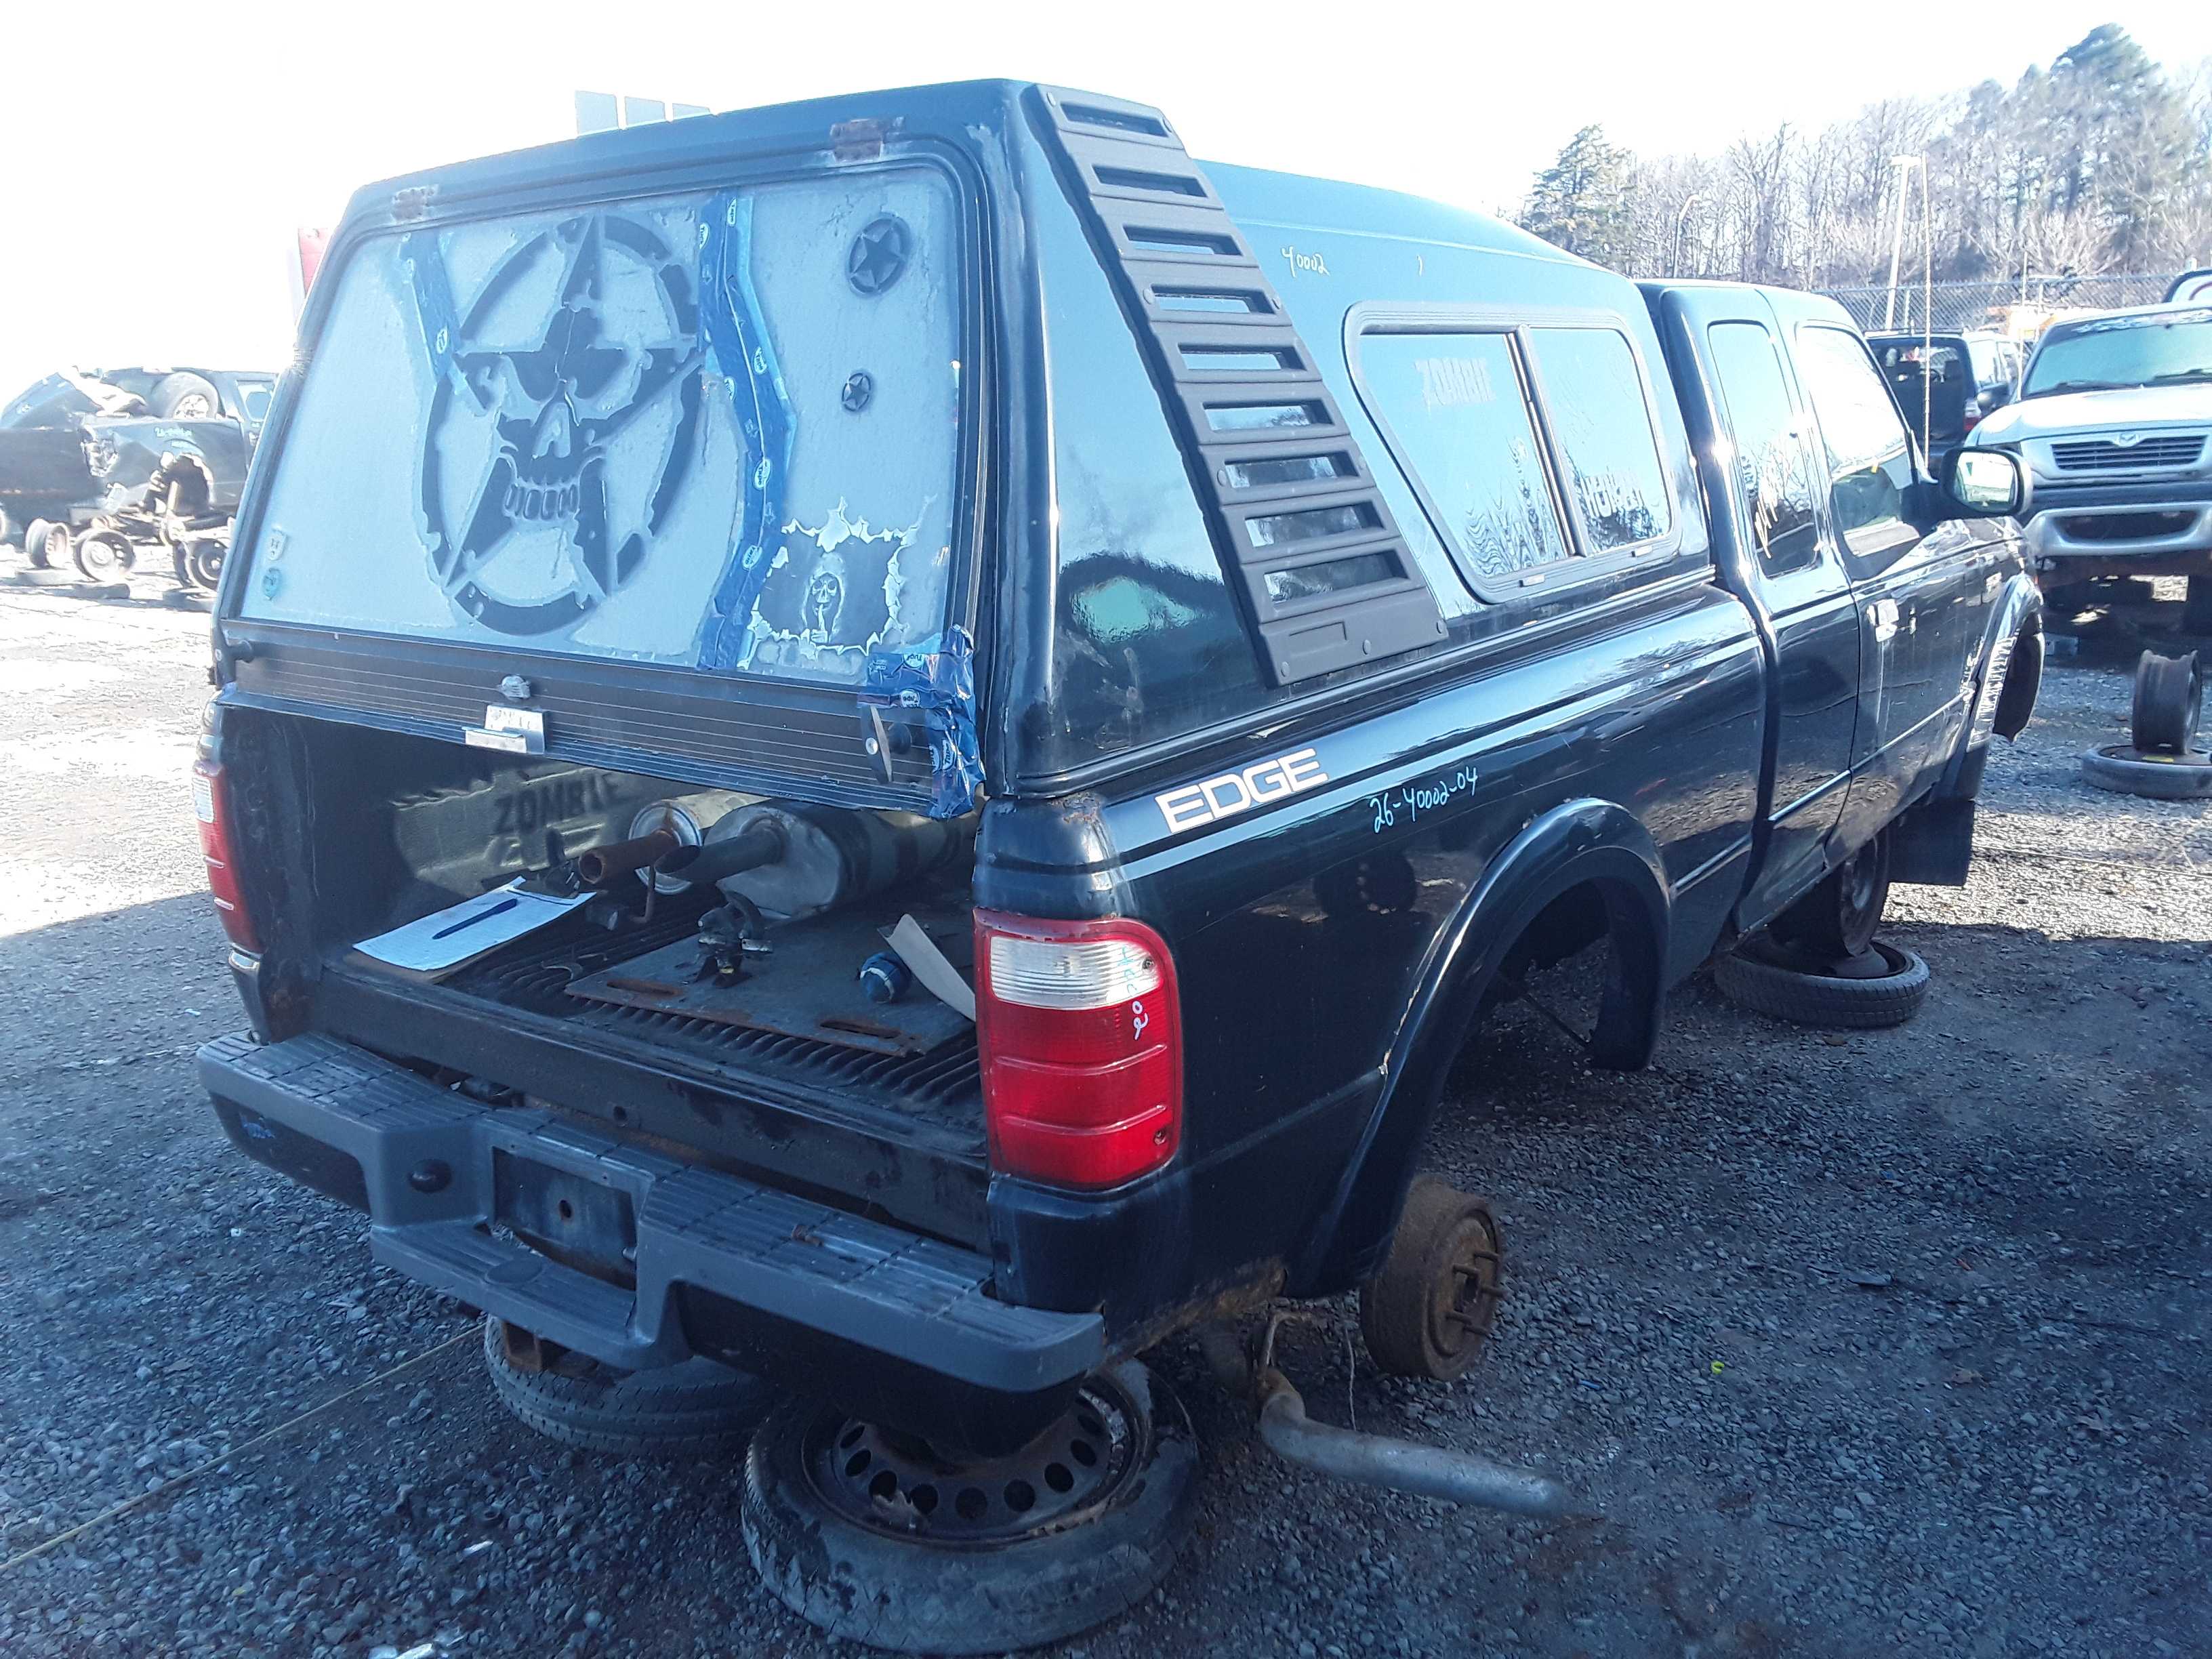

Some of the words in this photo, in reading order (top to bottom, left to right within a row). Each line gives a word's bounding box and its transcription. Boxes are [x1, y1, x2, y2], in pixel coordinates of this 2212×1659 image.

[1280, 245, 1331, 278] 40002
[1154, 747, 1329, 835] EDGE
[1369, 766, 1478, 834] 26-40002-04
